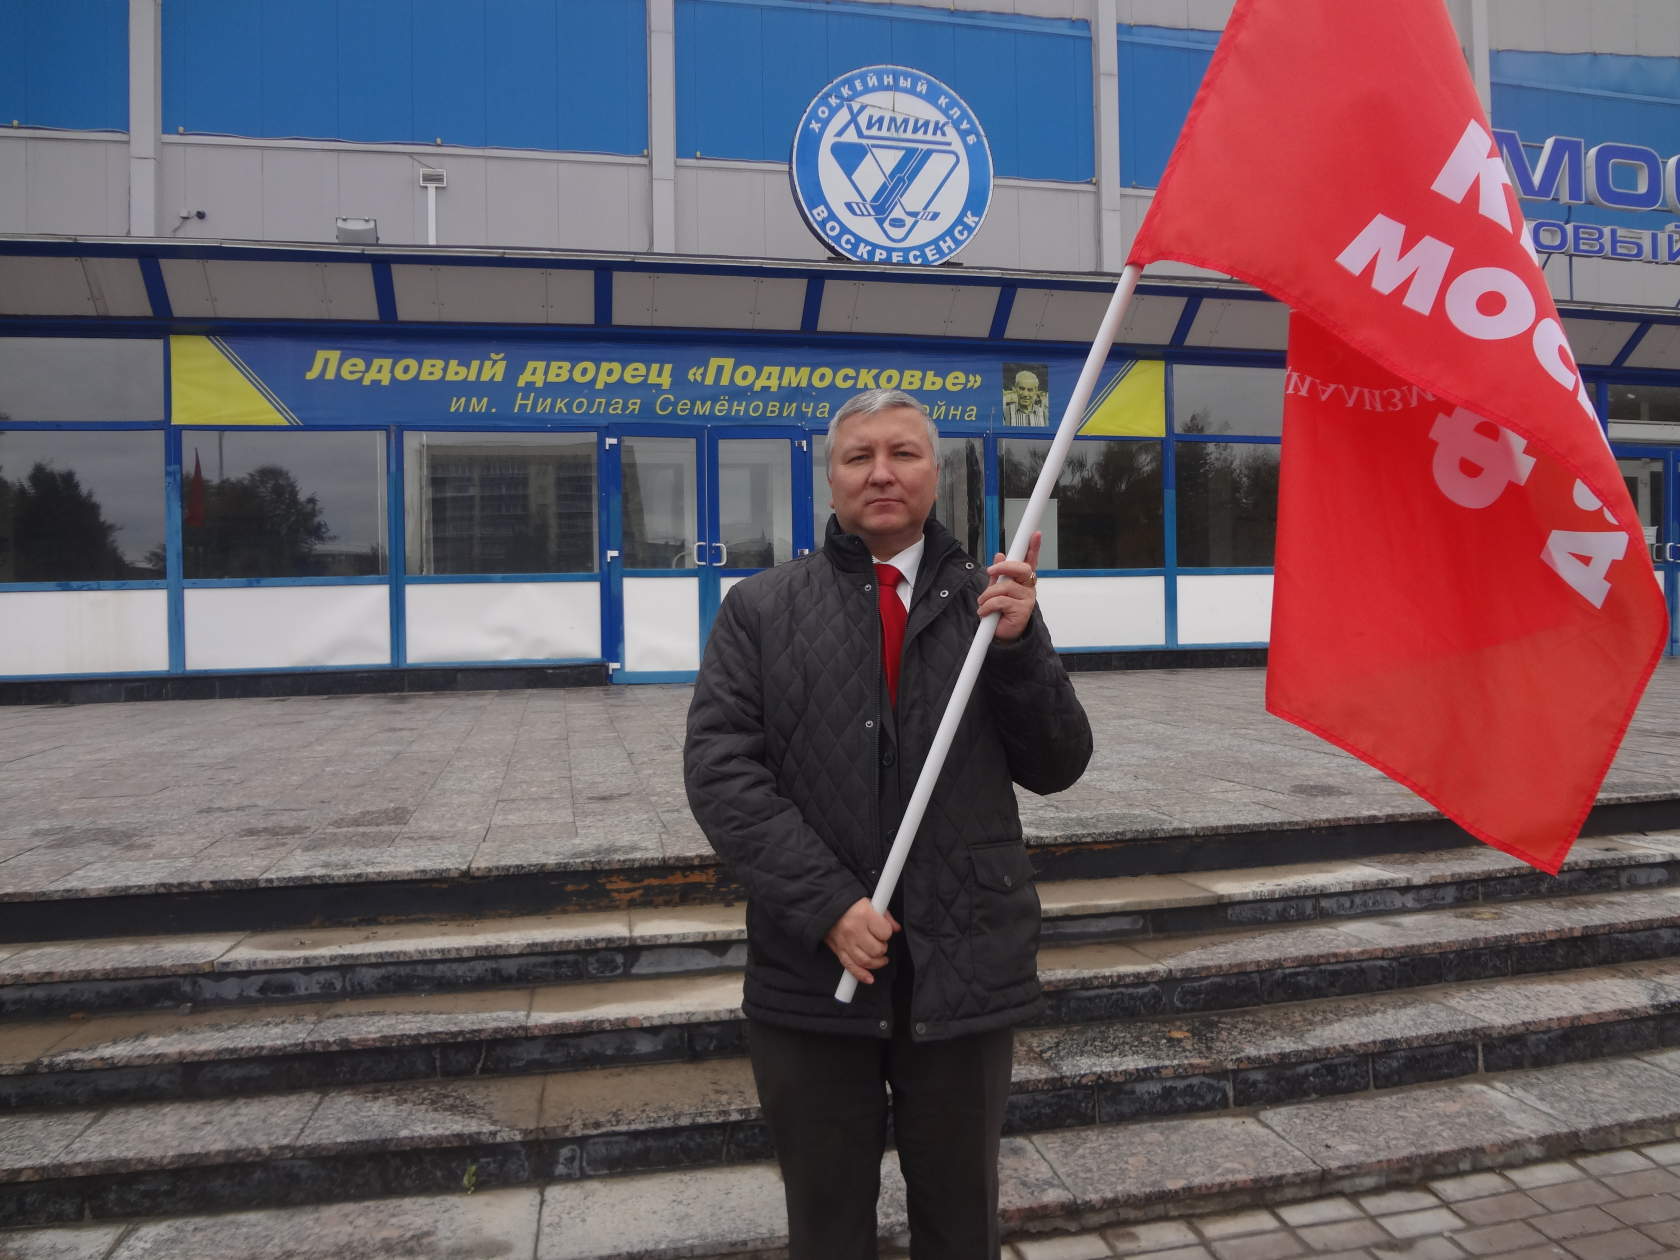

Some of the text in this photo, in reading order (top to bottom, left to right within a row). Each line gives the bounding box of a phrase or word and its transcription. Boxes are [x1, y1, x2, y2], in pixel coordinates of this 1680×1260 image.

[809, 72, 977, 145] ХОККЕЙНЫЙ КЛУБ
[811, 204, 980, 264] ВОСКРЕСЕНСК
[305, 349, 982, 392] Ледовый дворец «Подмосковье»
[450, 396, 497, 413] им.
[514, 392, 642, 415] Николая
[655, 393, 830, 418] Семёновича
